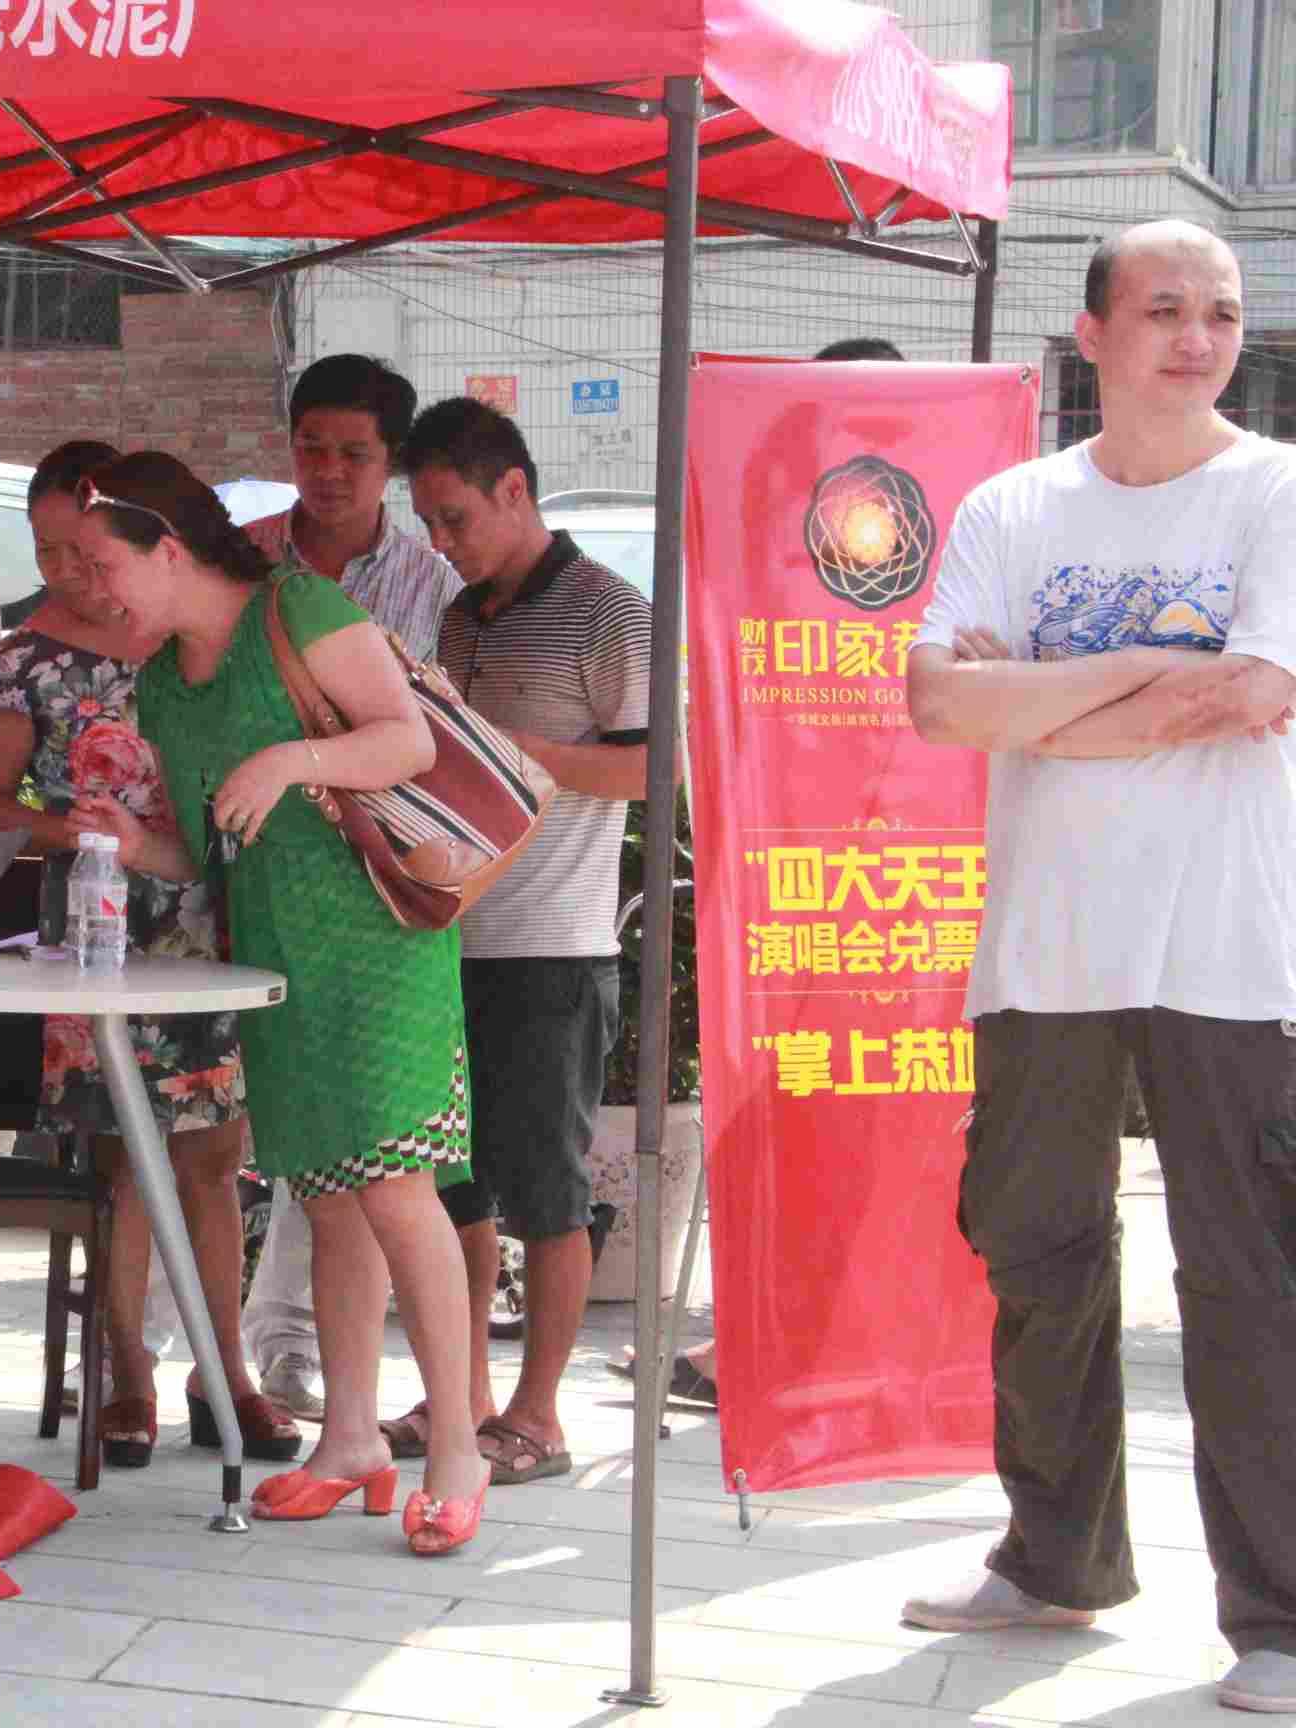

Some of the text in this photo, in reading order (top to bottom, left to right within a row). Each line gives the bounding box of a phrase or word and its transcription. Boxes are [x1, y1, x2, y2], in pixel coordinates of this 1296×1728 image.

[742, 687, 868, 705] IMPRESSION
[746, 920, 977, 976] 演唱会兑票
